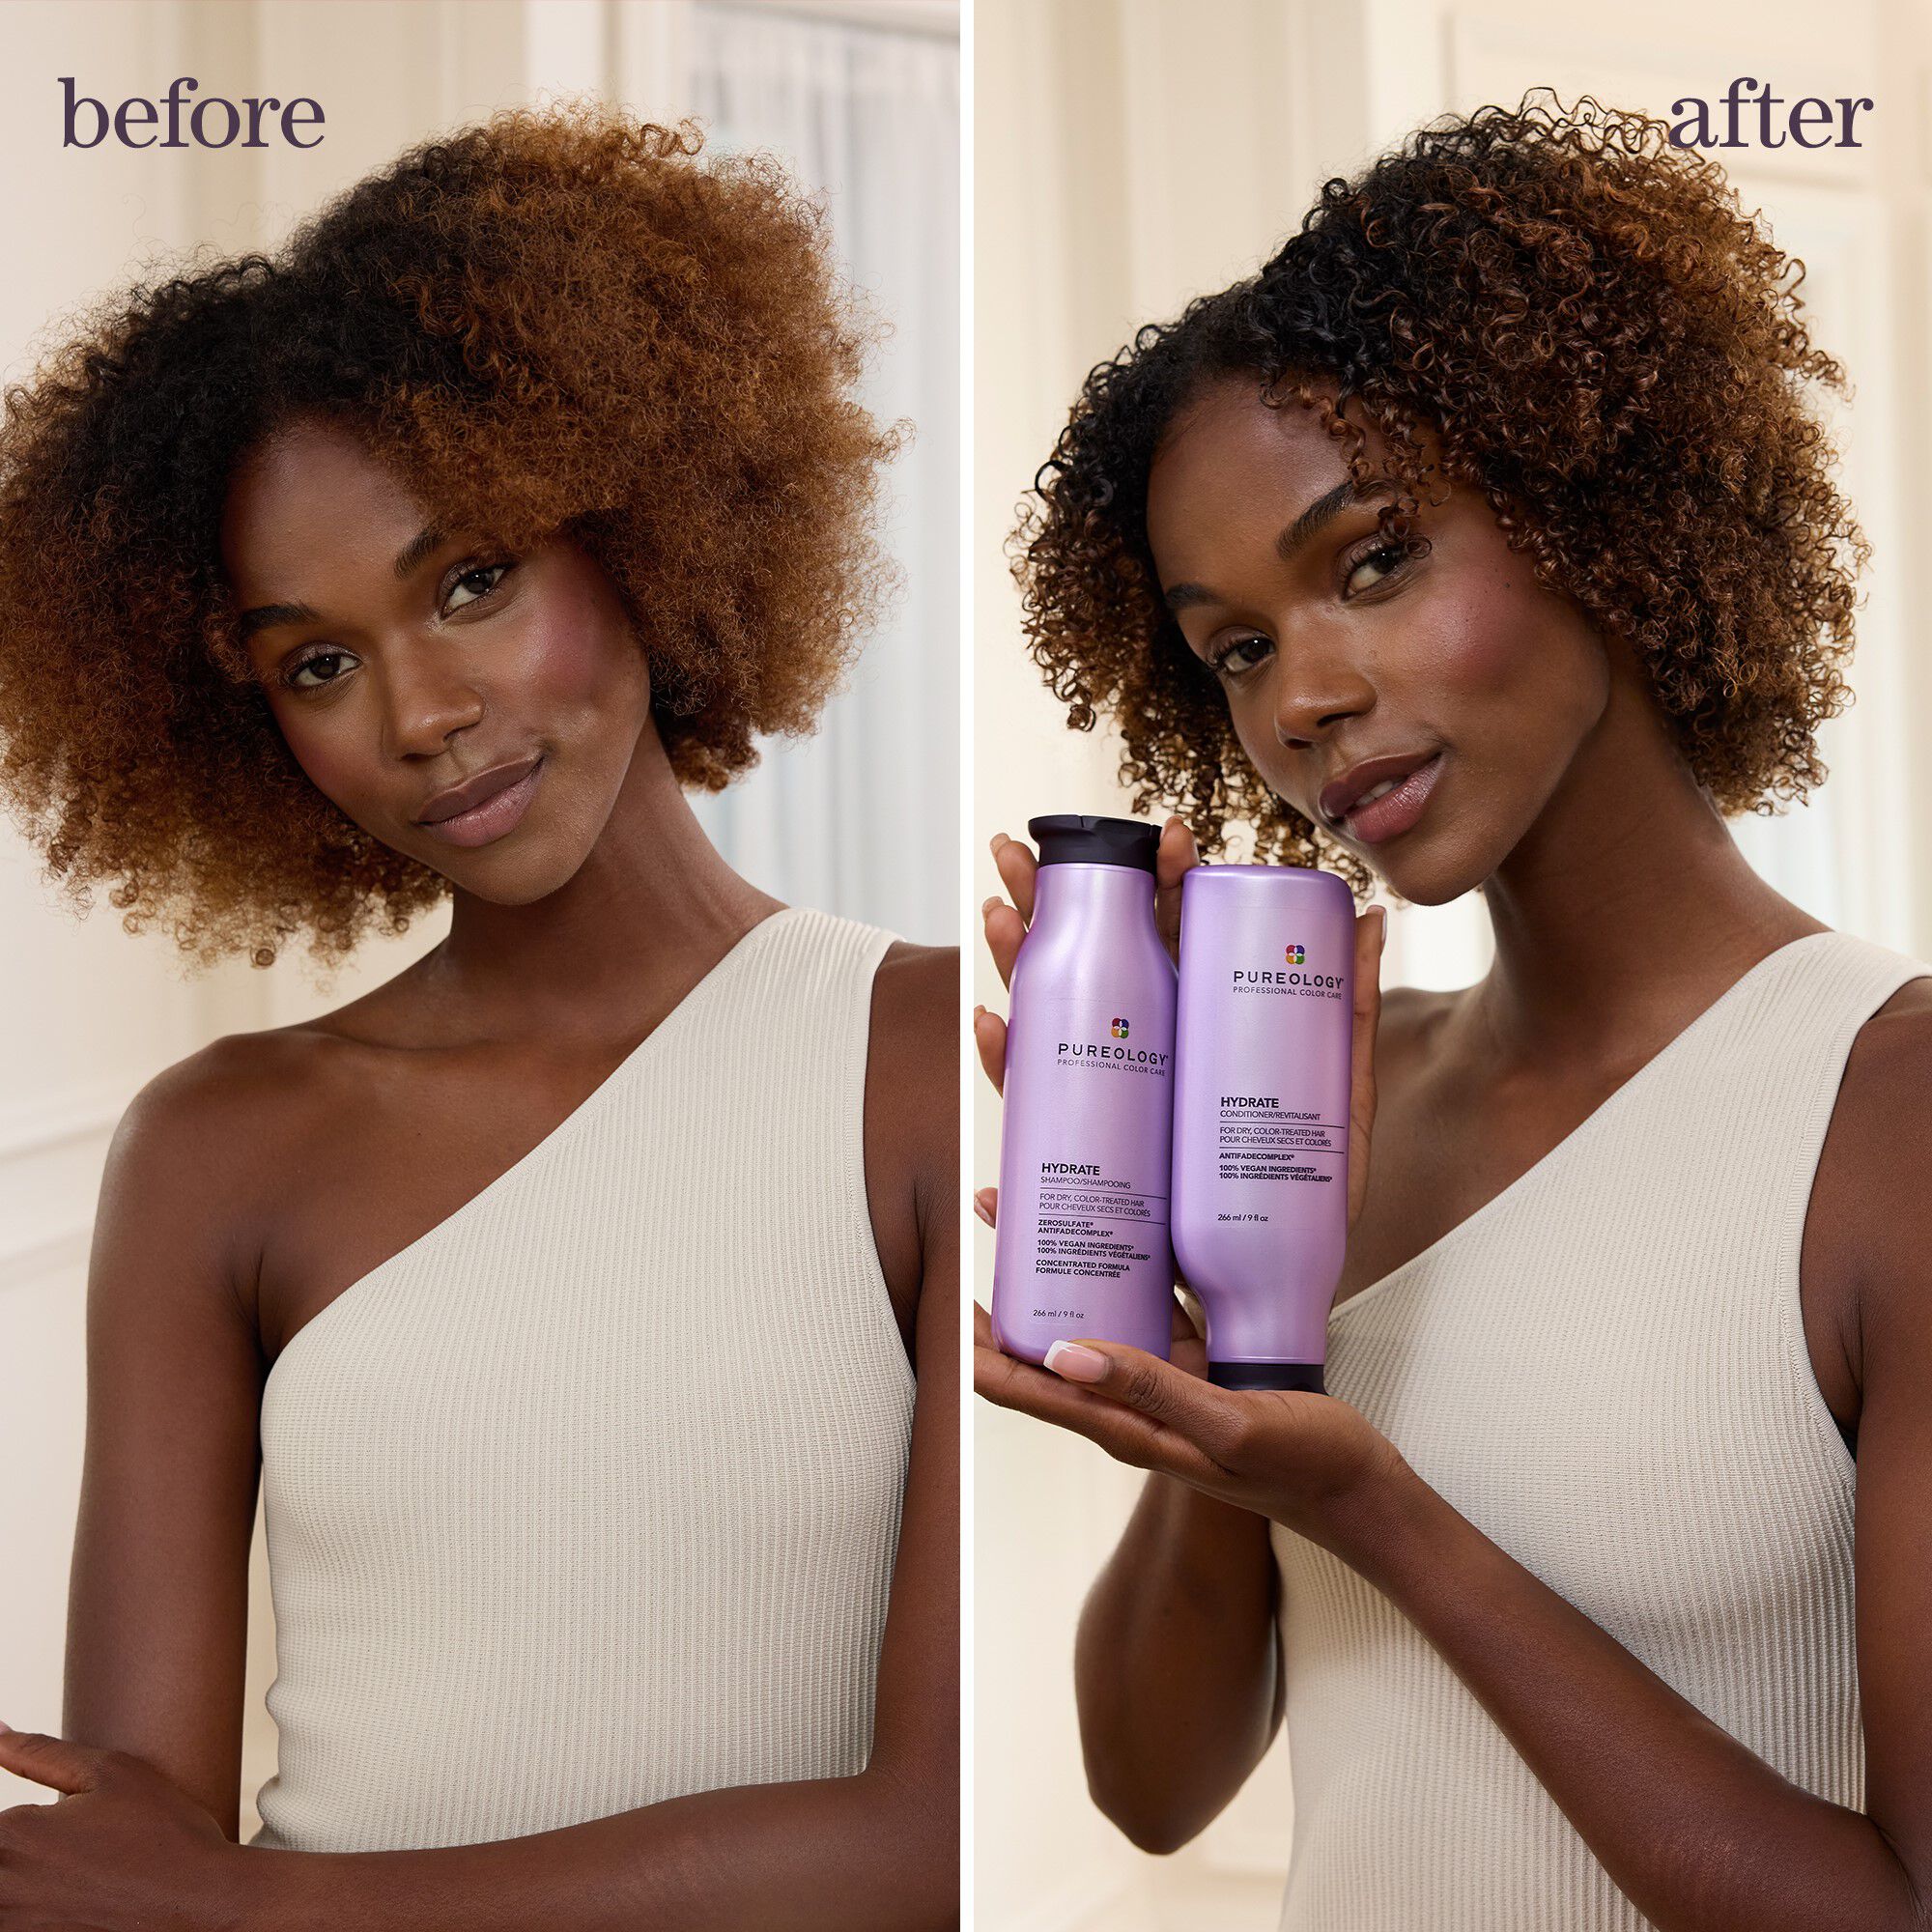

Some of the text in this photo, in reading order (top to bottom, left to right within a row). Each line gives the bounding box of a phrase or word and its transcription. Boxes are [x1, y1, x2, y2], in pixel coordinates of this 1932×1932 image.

[1234, 986, 1296, 995] PROFESSIONAL
[1058, 1059, 1121, 1070] PROFESSIONAL
[1123, 1065, 1149, 1073] COLOR
[1221, 1097, 1279, 1108] HYDRATE
[1220, 1110, 1321, 1121] CONDITIONER/REVITALISANT
[1254, 1127, 1310, 1136] COLOR-TREATED
[1241, 1136, 1275, 1145] CHEVEUX
[1042, 1163, 1100, 1176] HYDRATE
[1040, 1177, 1131, 1189] SHAMPOO/SHAMPOOING
[1074, 1195, 1129, 1206] COLOR-TREATED
[1062, 1203, 1095, 1212] CHEVEUX
[1059, 1248, 1107, 1257] INGRÉDIENTS
[1036, 1260, 1130, 1271] CONCENTRATED FORMULA
[1073, 1268, 1121, 1278] CONCENTRÉE
